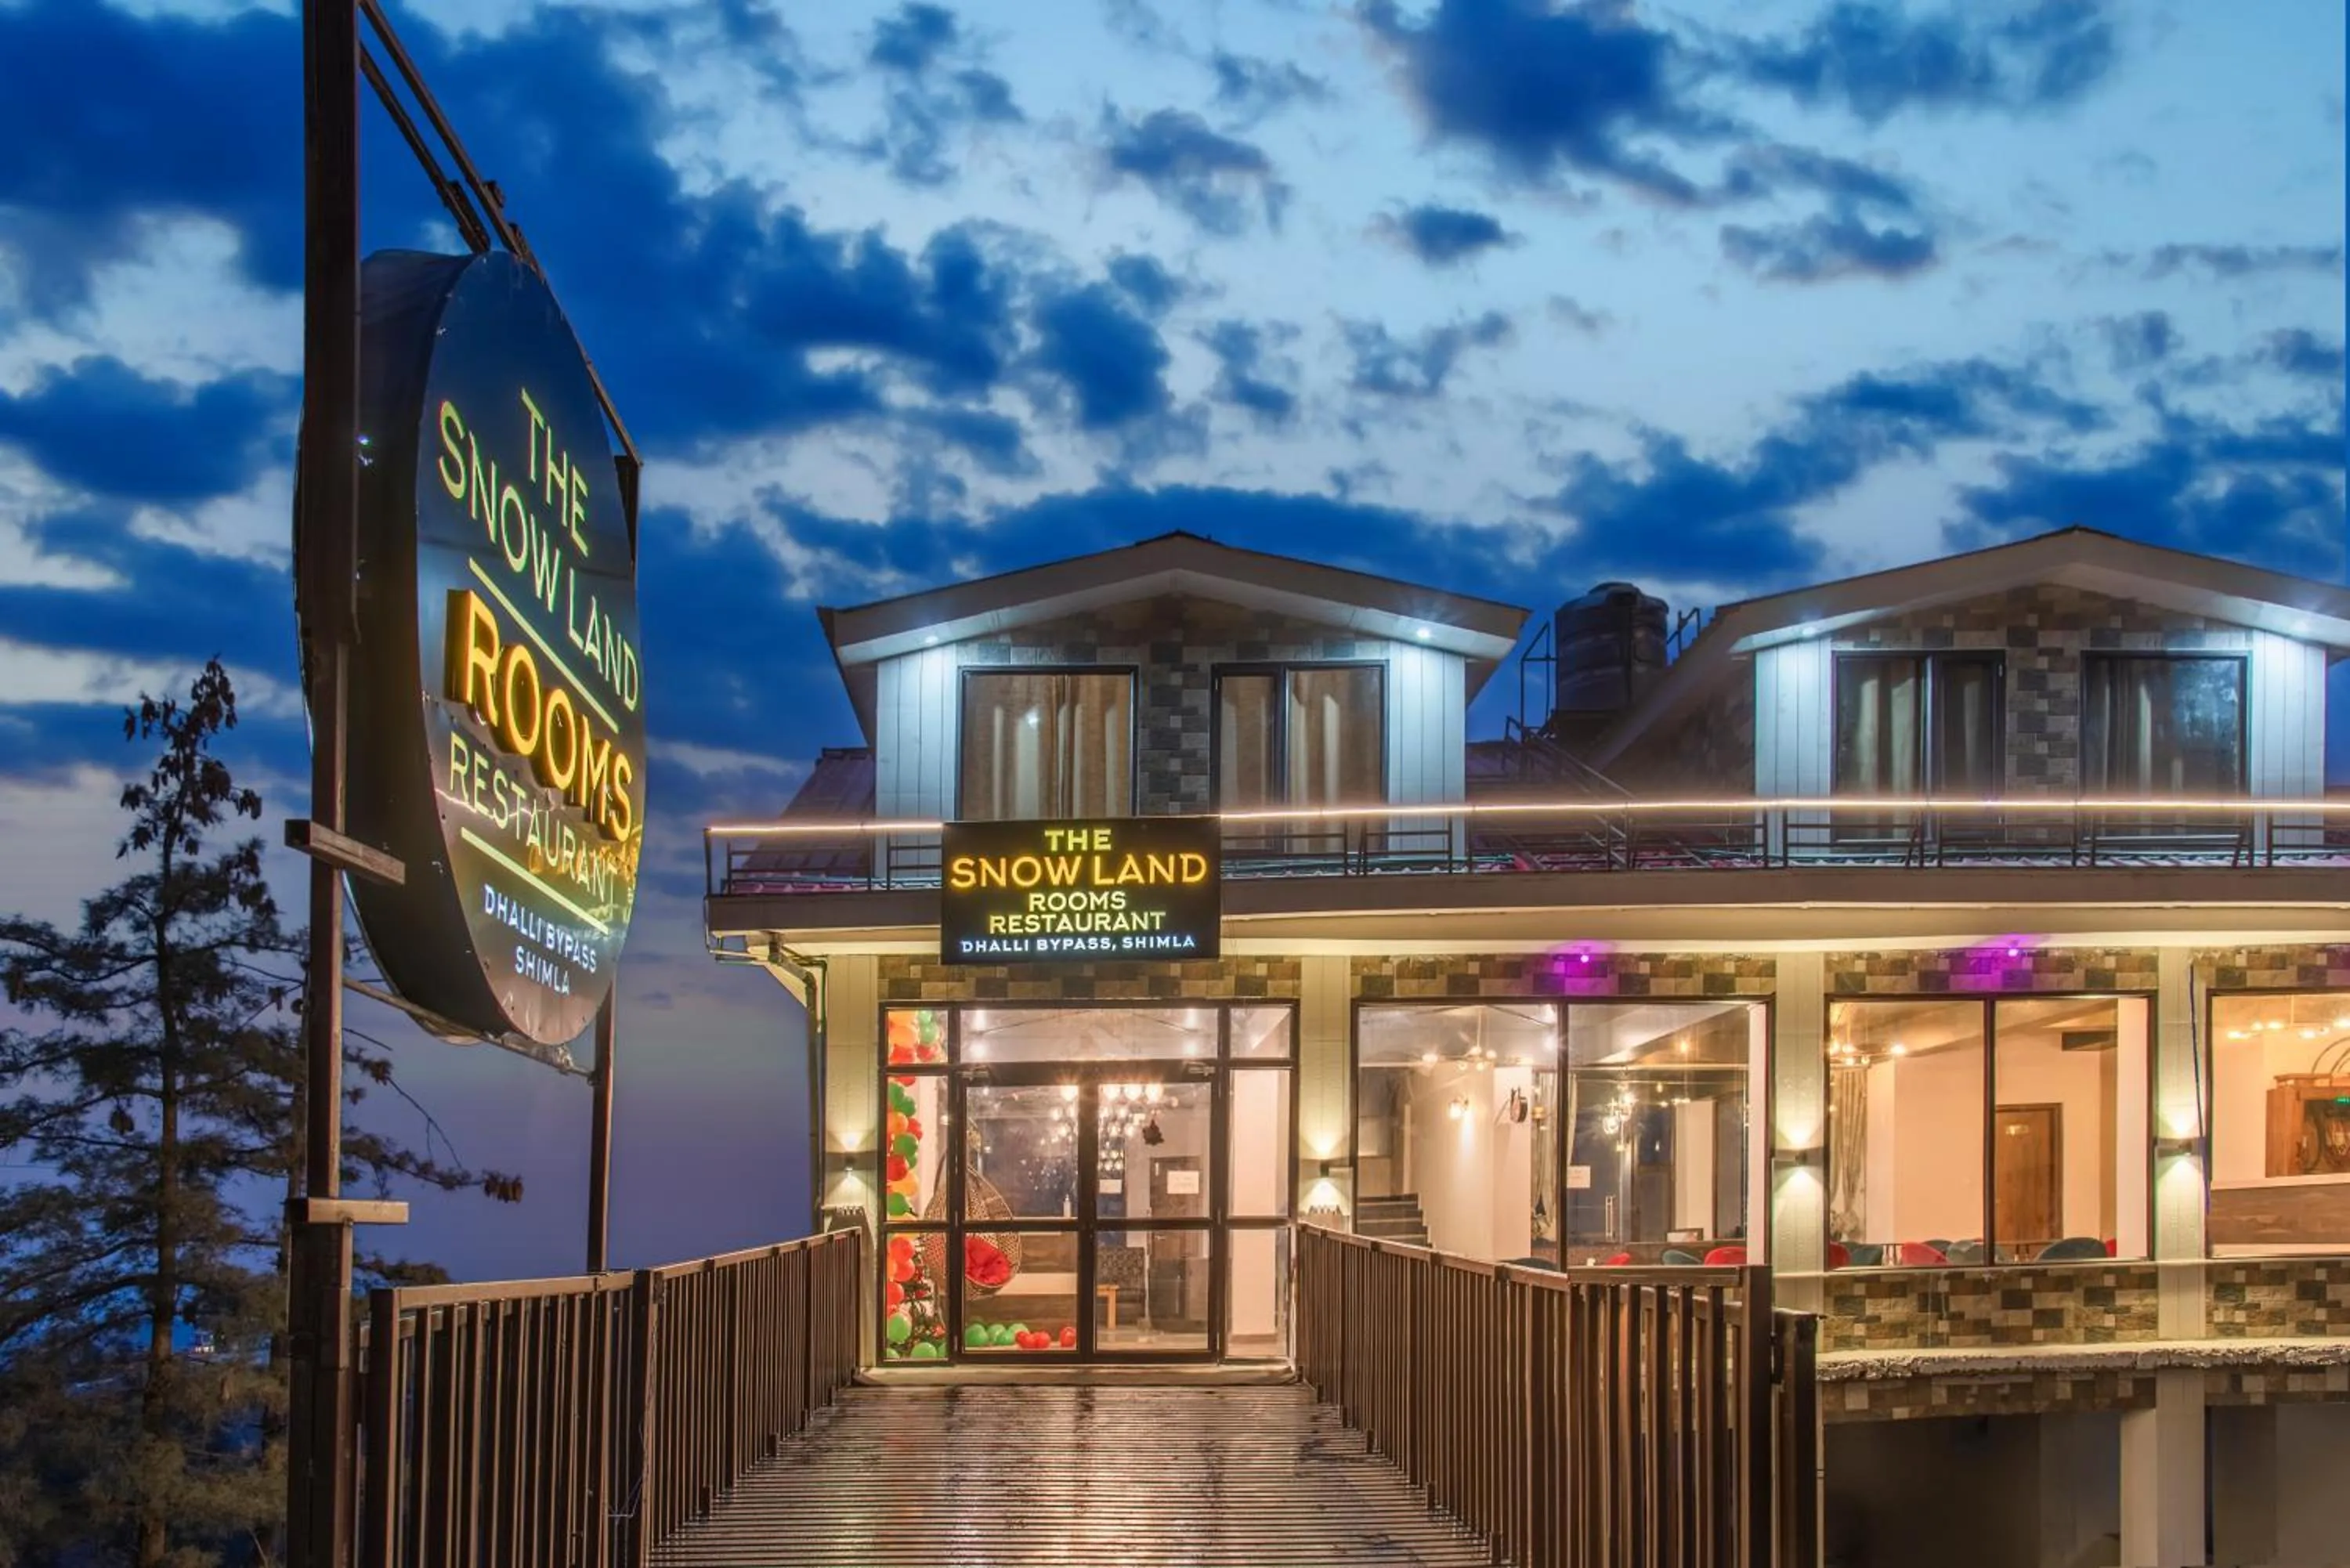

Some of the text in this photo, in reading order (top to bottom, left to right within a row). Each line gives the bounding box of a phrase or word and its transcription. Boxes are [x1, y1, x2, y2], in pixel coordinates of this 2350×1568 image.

[521, 387, 588, 558] THE
[439, 399, 639, 711] SNOW LAND
[466, 589, 632, 842] ROOMS
[450, 730, 618, 915] RESTAURANT
[1045, 829, 1112, 851] THE
[951, 853, 1207, 887] SNOW LAND
[989, 911, 1166, 934] RESTAURANT
[1029, 891, 1126, 912] ROOMS
[484, 883, 597, 974] DHALLI BYPASS
[961, 935, 1195, 953] DHALLI BYPASS, SHIMLA
[515, 945, 570, 995] SHIMLA
